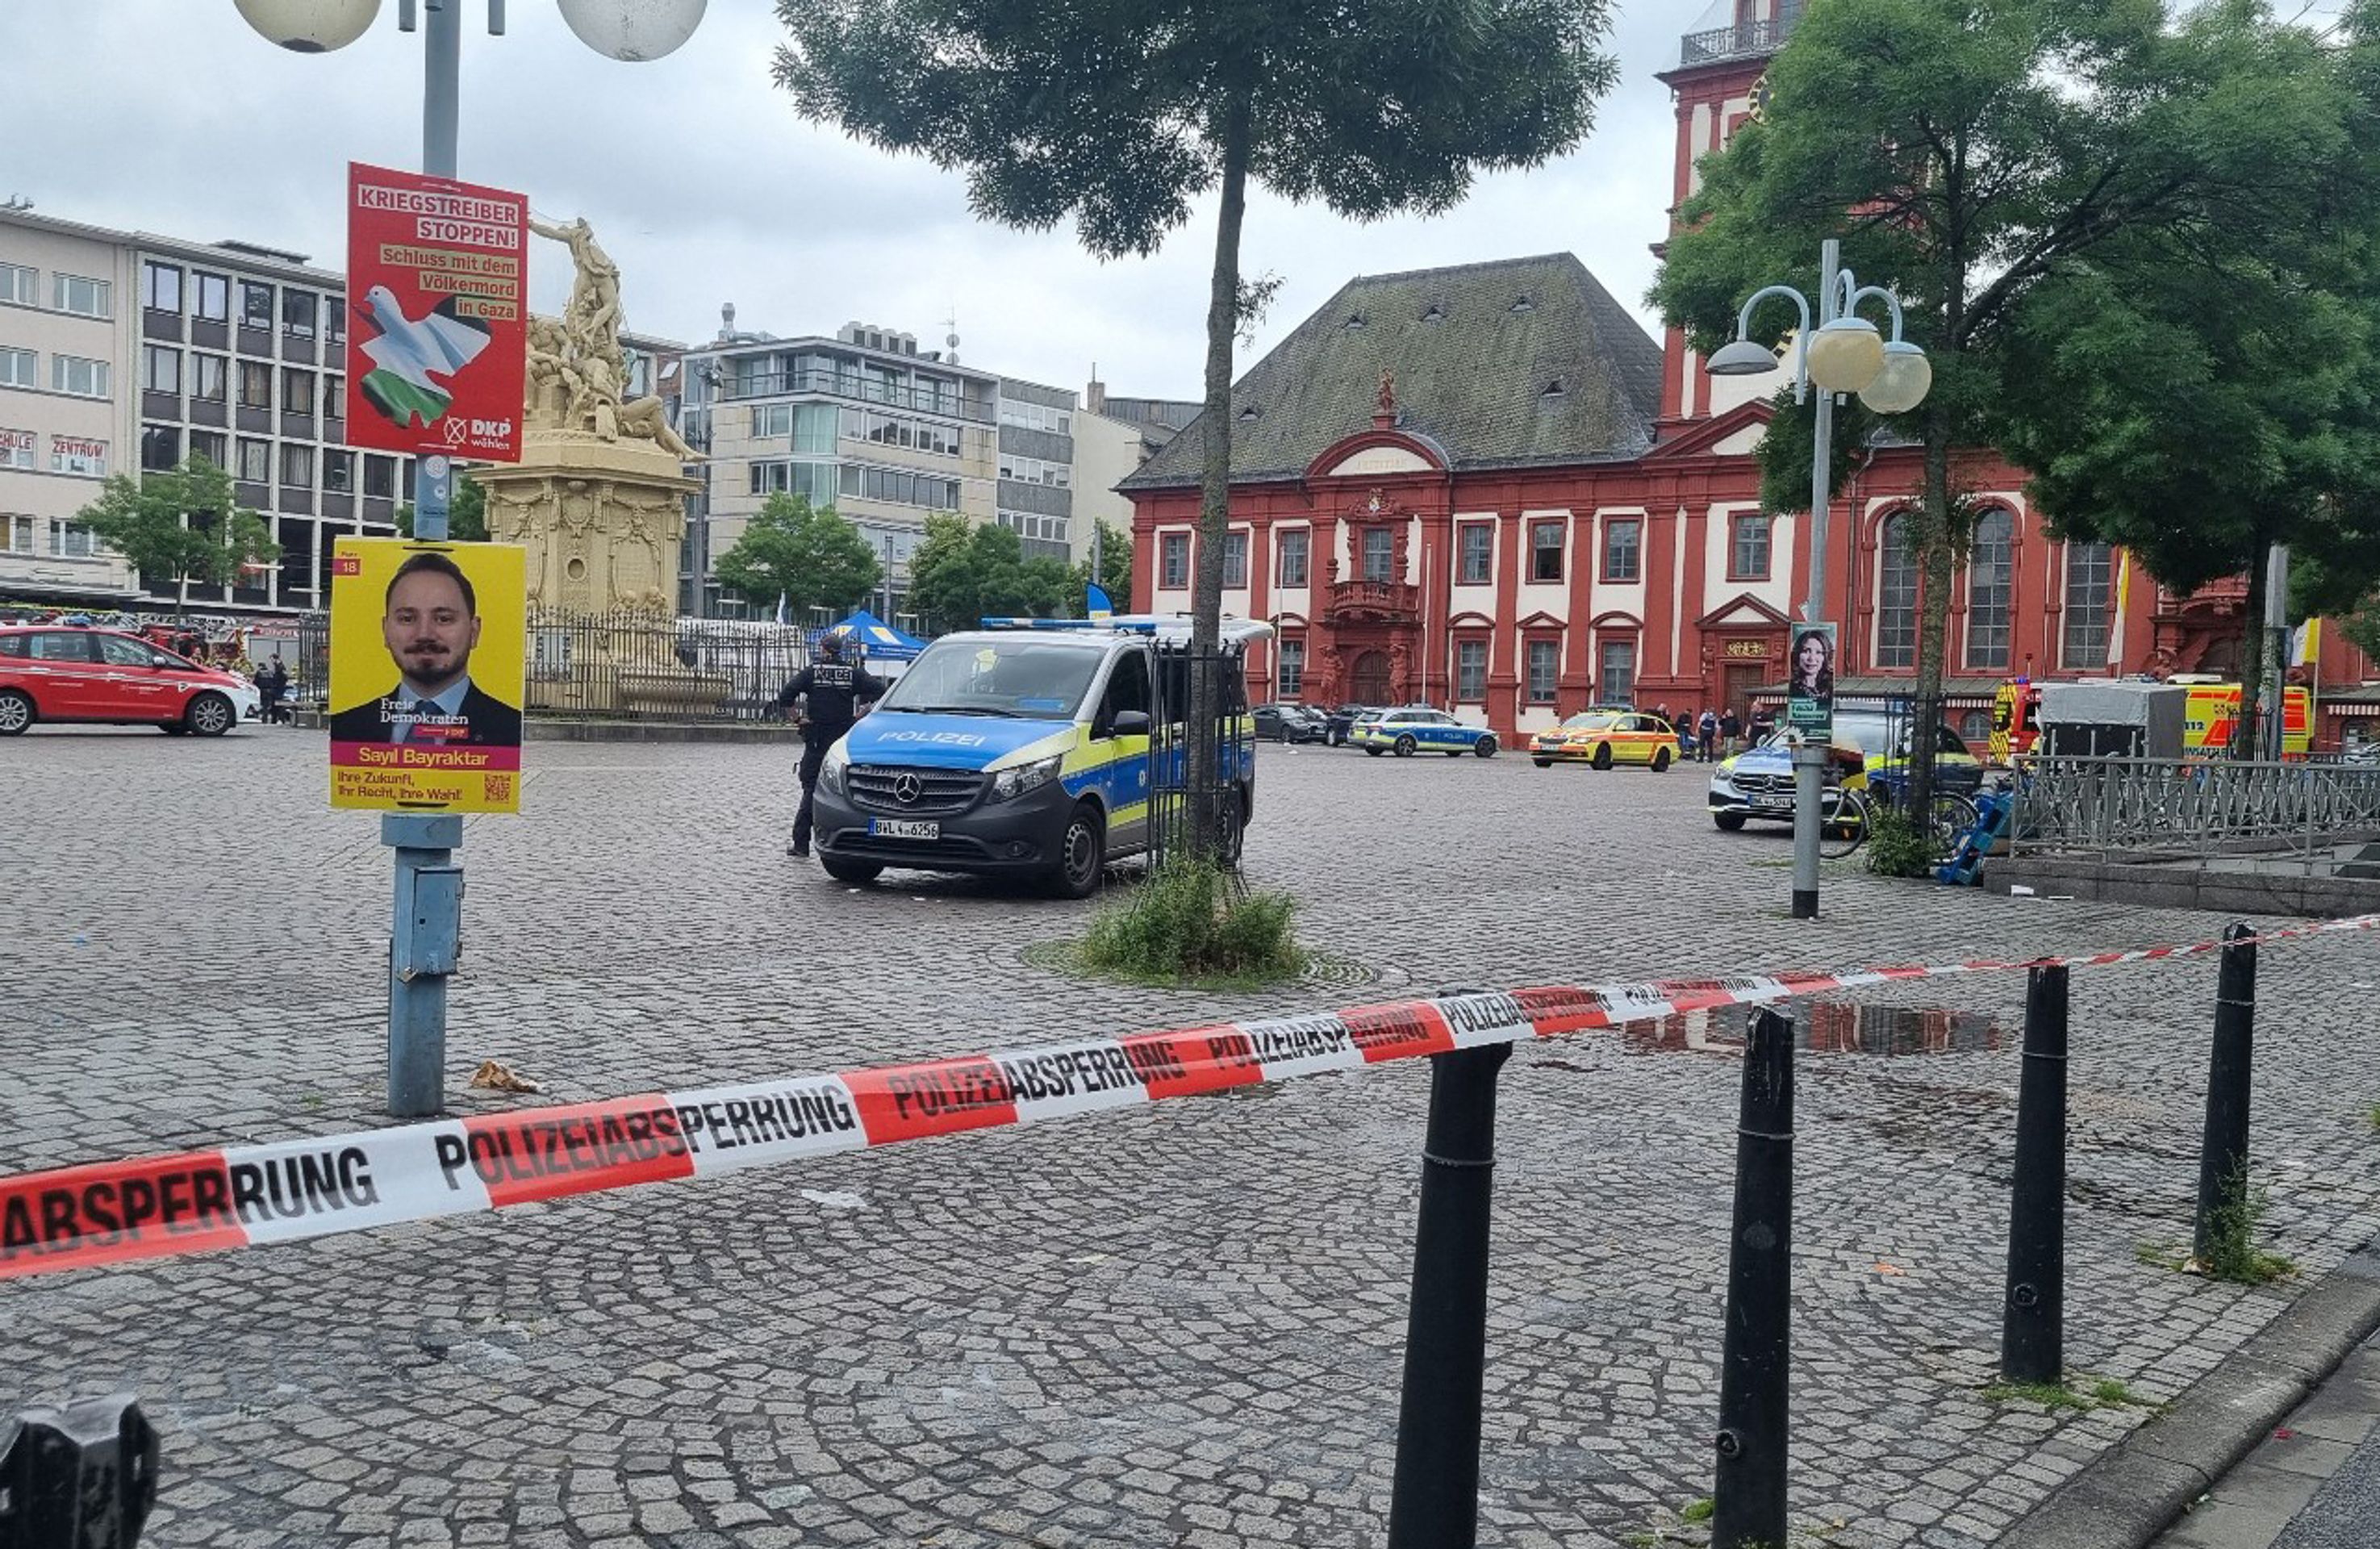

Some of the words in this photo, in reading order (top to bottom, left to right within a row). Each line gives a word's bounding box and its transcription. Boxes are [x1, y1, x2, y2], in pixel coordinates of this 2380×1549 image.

[361, 188, 516, 223] KRIEGSTREIBER
[420, 220, 516, 247] STOPPEN!
[383, 248, 446, 267] Schluss
[452, 255, 478, 270] mit
[483, 257, 515, 274] dem
[423, 274, 515, 296] Völkermord
[458, 299, 473, 314] in
[478, 302, 515, 319] Gaza
[471, 419, 511, 437] DKP
[52, 440, 103, 457] ZENTRUM
[471, 437, 510, 450] wählen
[343, 562, 357, 573] 18
[381, 698, 415, 710] Freie
[380, 711, 469, 724] Demokraten
[876, 730, 988, 747] POLIZEI
[403, 749, 489, 767] Bayraktar
[338, 771, 361, 783] Ihre
[364, 772, 415, 787] Zukunft,
[339, 785, 355, 797] Ihr
[357, 787, 396, 800] Recht,
[400, 788, 424, 800] Ihre
[887, 1040, 1187, 1119] POLIZEIABSPERRUNG
[434, 1085, 856, 1190] POLIZEIABSPERRUNG
